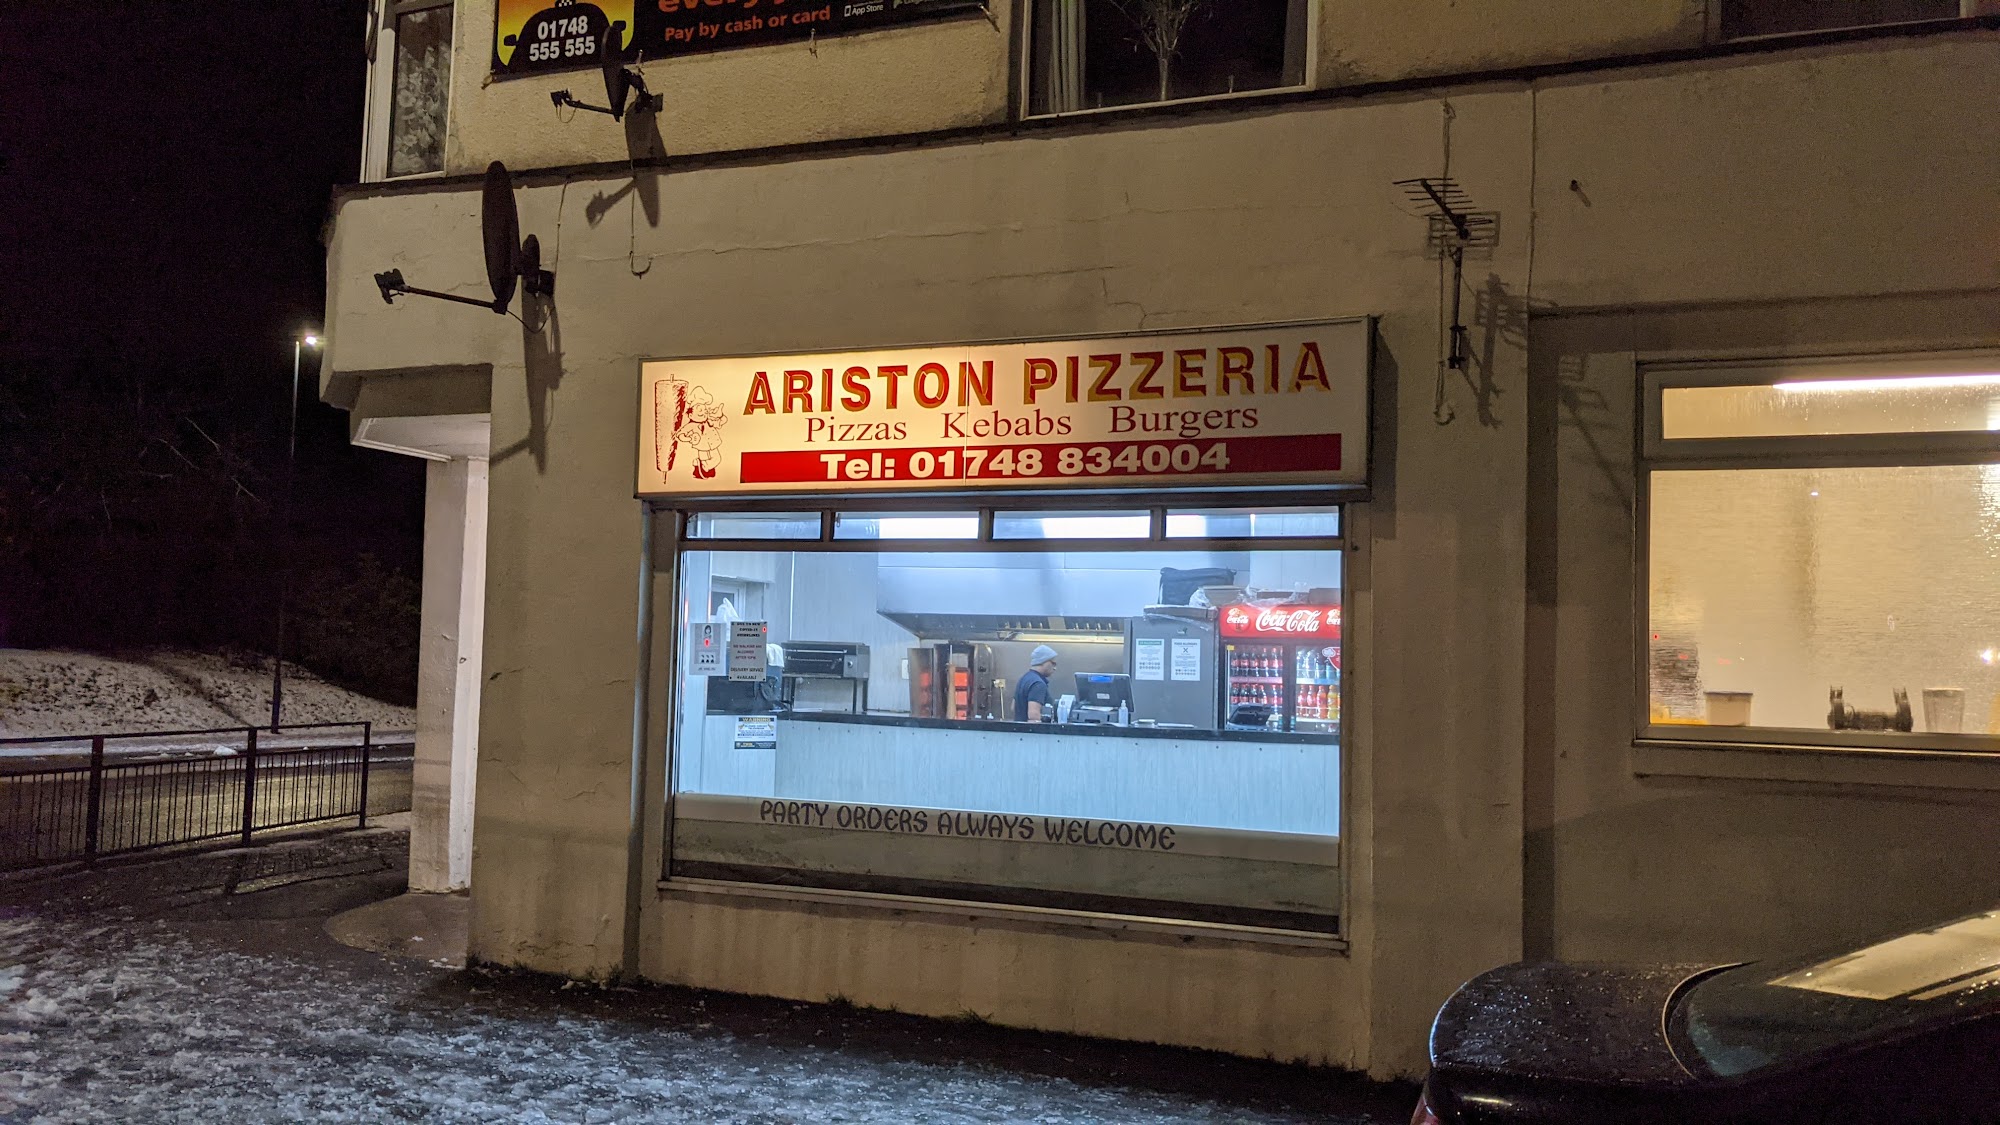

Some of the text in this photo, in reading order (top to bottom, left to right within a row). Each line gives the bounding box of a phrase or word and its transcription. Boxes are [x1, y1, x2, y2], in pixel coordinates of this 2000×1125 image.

[537, 15, 588, 40] 01748
[664, 26, 695, 42] Pay
[699, 22, 720, 39] by
[724, 15, 763, 33] cash
[768, 14, 788, 28] or
[792, 5, 831, 23] card
[852, 4, 884, 16] App Store
[529, 36, 595, 62] 555 555
[743, 341, 1332, 416] ARISTON PIZZERIA
[804, 405, 1259, 443] Pizzas Kebabs Burgers
[820, 442, 1231, 480] Tel: 01748 834004
[1255, 609, 1322, 632] Coca-Cola
[760, 800, 1176, 850] PARTY ORDERS ALWAYS WELCOME
